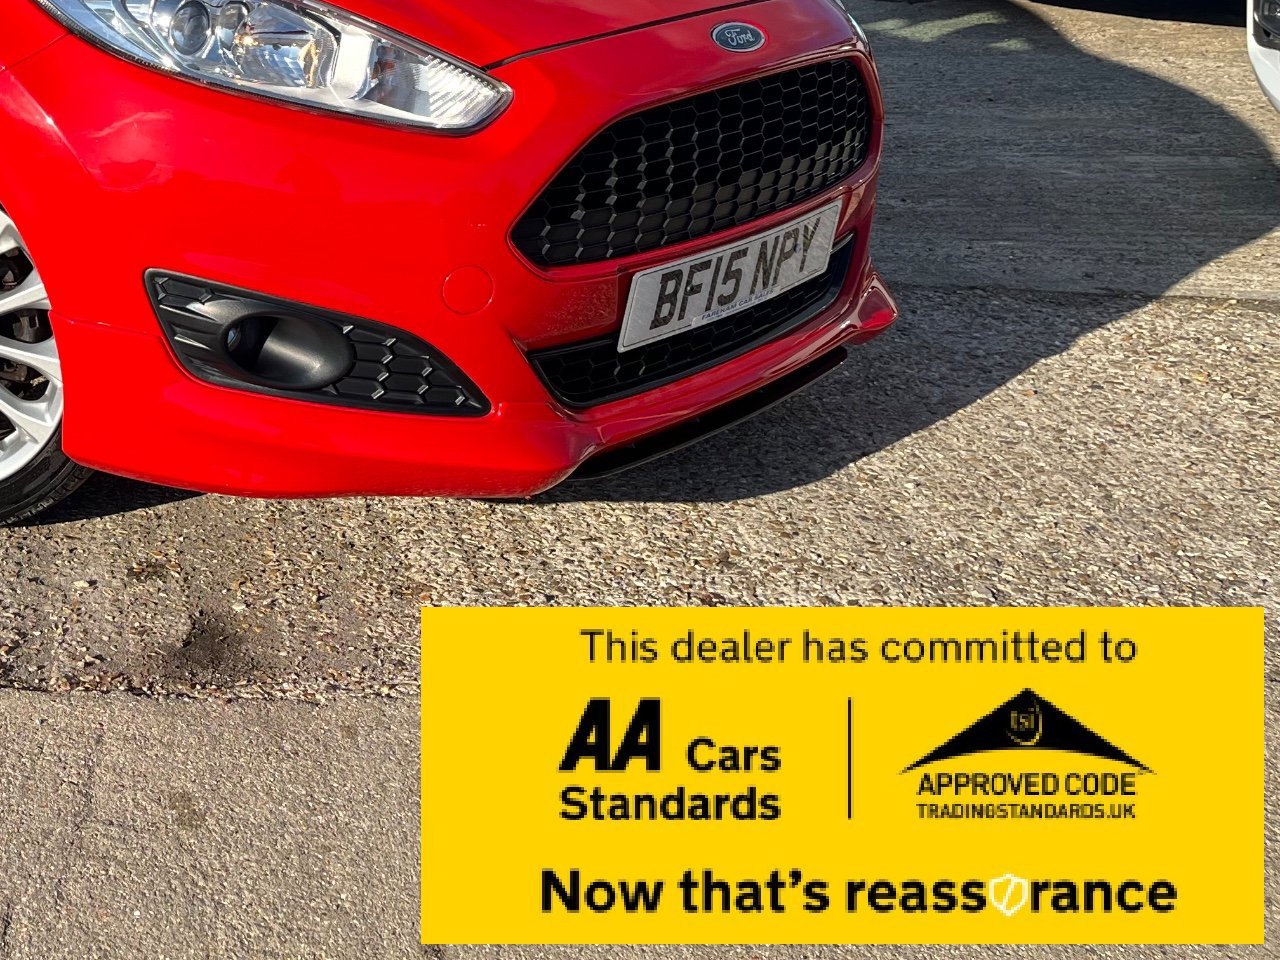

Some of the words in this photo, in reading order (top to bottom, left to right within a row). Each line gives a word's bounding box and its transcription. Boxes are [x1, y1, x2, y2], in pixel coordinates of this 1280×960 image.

[724, 28, 756, 46] Ford
[649, 247, 748, 330] BF15
[750, 217, 821, 295] NPY
